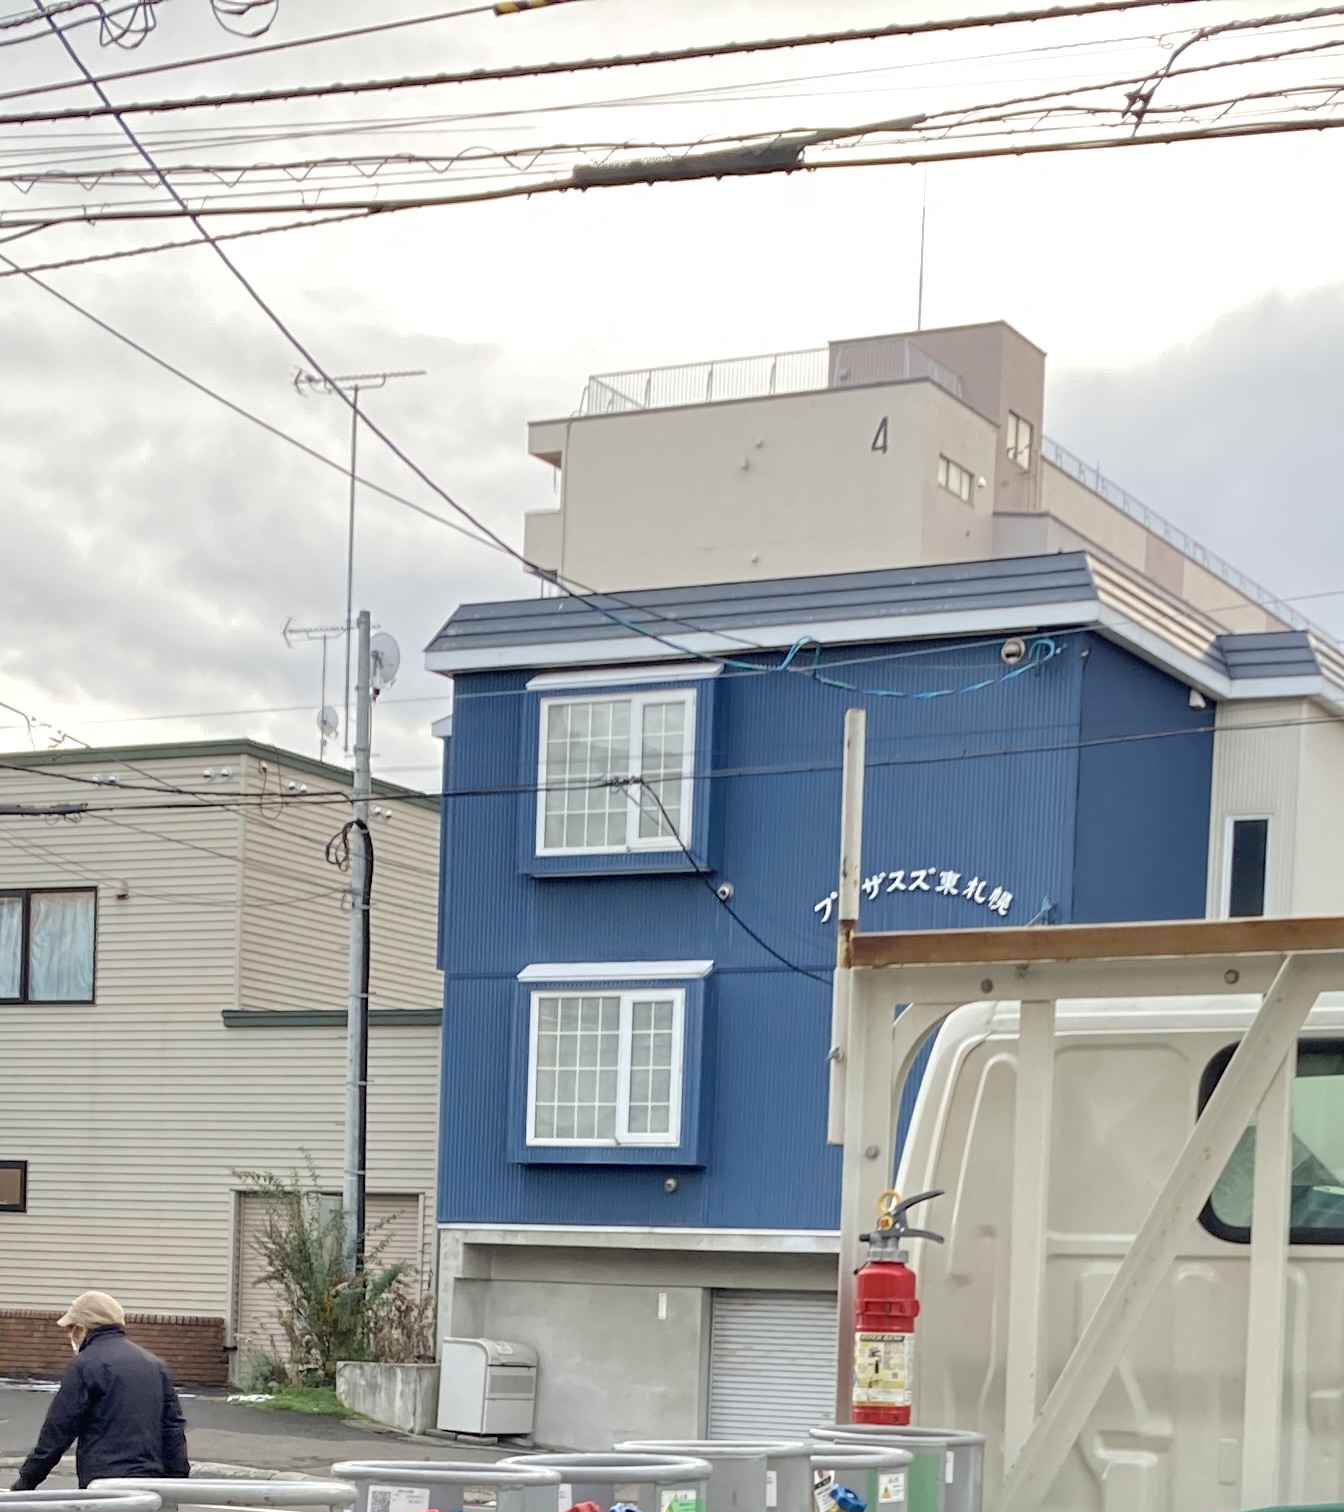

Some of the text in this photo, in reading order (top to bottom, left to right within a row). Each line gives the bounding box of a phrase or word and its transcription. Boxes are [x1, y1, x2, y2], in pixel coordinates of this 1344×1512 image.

[871, 416, 888, 454] 4
[814, 867, 1014, 922] プザスズ東札幌
